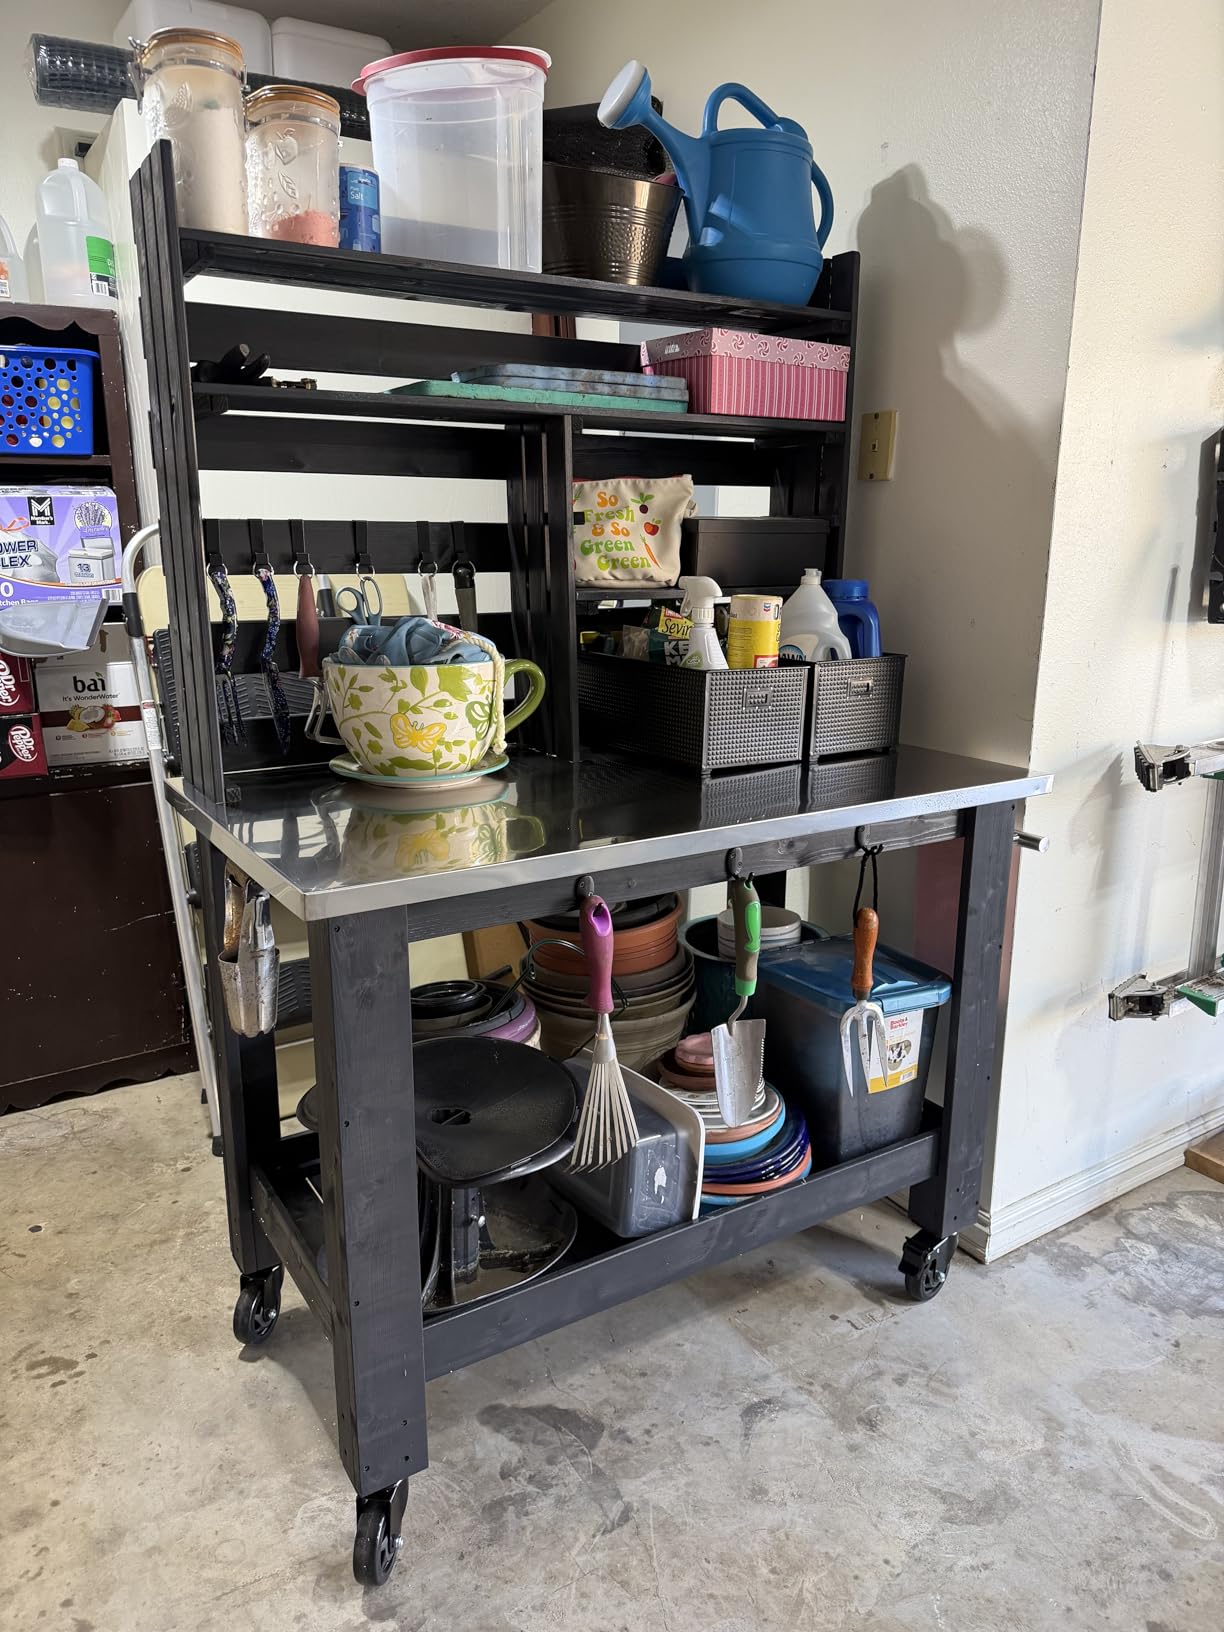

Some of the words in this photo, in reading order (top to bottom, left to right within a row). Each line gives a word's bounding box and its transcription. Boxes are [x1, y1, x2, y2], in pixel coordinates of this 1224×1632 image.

[350, 191, 364, 201] Salt
[597, 491, 618, 508] So
[584, 505, 634, 523] Fresh
[591, 523, 604, 537] &
[610, 521, 630, 537] So
[580, 539, 635, 556] Green
[77, 563, 91, 572] 13
[597, 554, 652, 571] Green
[73, 673, 106, 693] bai
[73, 693, 119, 701] WonderWater
[10, 726, 32, 759] Pepper
[22, 737, 35, 751] Dr
